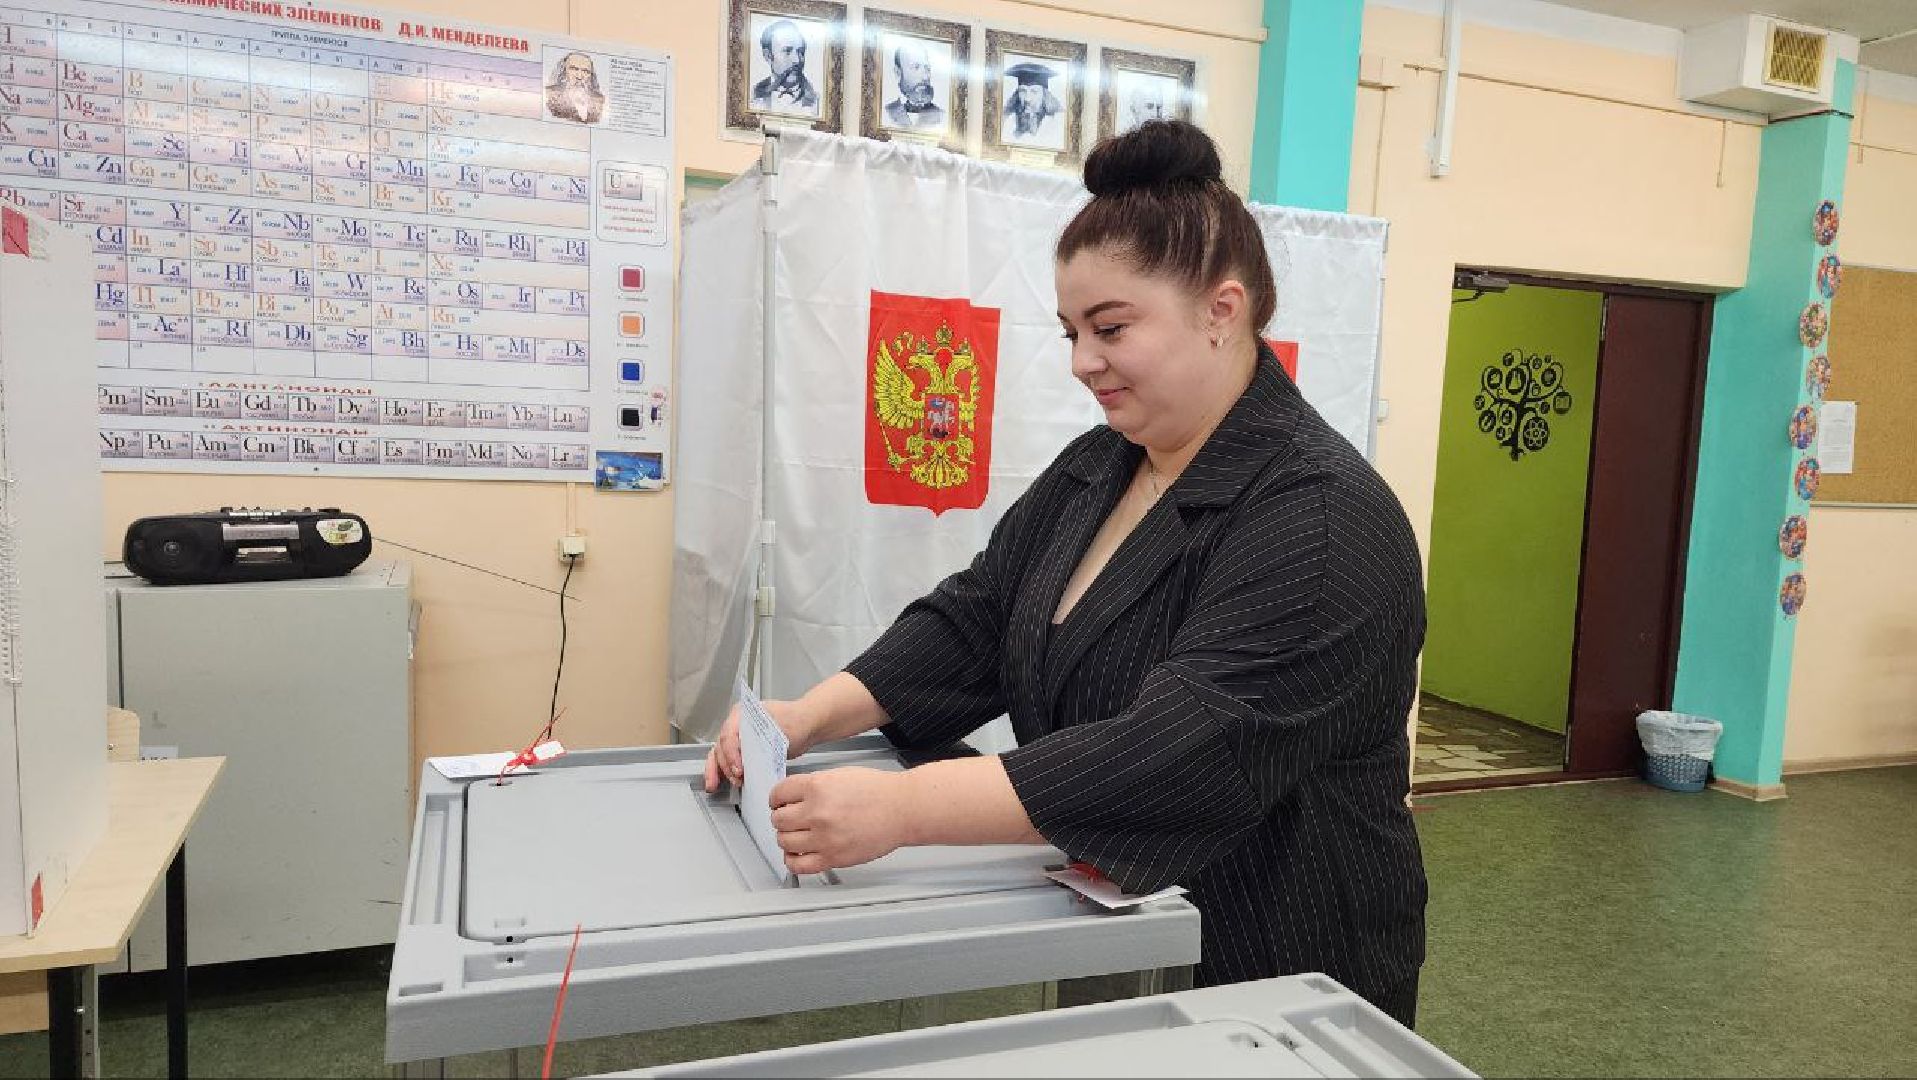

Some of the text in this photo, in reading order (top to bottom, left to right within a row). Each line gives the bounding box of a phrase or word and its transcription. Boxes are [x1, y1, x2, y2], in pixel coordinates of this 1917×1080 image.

[286, 7, 383, 31] ЭЛЕМЕНТОВ
[398, 22, 429, 38] Д.И.
[431, 27, 529, 53] МЕНДЕЛЕЕВА
[64, 63, 87, 81] Be
[64, 94, 94, 116] Mg
[64, 123, 87, 141] Ca
[28, 149, 56, 168] Cu
[96, 155, 122, 174] Zn
[346, 153, 367, 170] Cr
[397, 159, 424, 177] Mn
[509, 171, 532, 189] Co
[64, 193, 86, 212] Sr
[228, 208, 248, 226] Zr
[283, 213, 311, 231] Nb
[96, 226, 122, 245] Cd
[341, 219, 367, 236] Mo
[455, 229, 478, 247] Ru
[508, 234, 532, 252] Rh
[565, 240, 586, 257] Pd
[347, 274, 367, 291] W
[404, 277, 426, 295] Re
[457, 282, 479, 299] Os
[96, 283, 125, 304] Hg
[518, 286, 532, 303] Ir
[285, 324, 311, 341] Db
[346, 328, 369, 348] Sg
[401, 331, 424, 348] Bh
[456, 334, 479, 351] Hs
[509, 337, 529, 355] Mt
[565, 341, 586, 358] Ds
[144, 389, 174, 407] Sm
[196, 391, 219, 409] Eu
[244, 393, 271, 411] Gd
[291, 394, 317, 412] Tb
[383, 400, 408, 417] Ho
[427, 401, 445, 417] Er
[467, 403, 493, 420] Tm
[511, 405, 534, 421] Yb
[222, 424, 369, 436] АКТИНОИДЫ
[148, 433, 171, 451] Pu
[195, 434, 227, 451] Am
[243, 436, 275, 453] Cm
[294, 437, 316, 454] Bk
[338, 439, 357, 456] Cf
[383, 441, 403, 457] Es
[426, 442, 453, 459] Fm
[467, 444, 493, 460] Md
[511, 446, 532, 460] No
[552, 446, 570, 461] Lr
